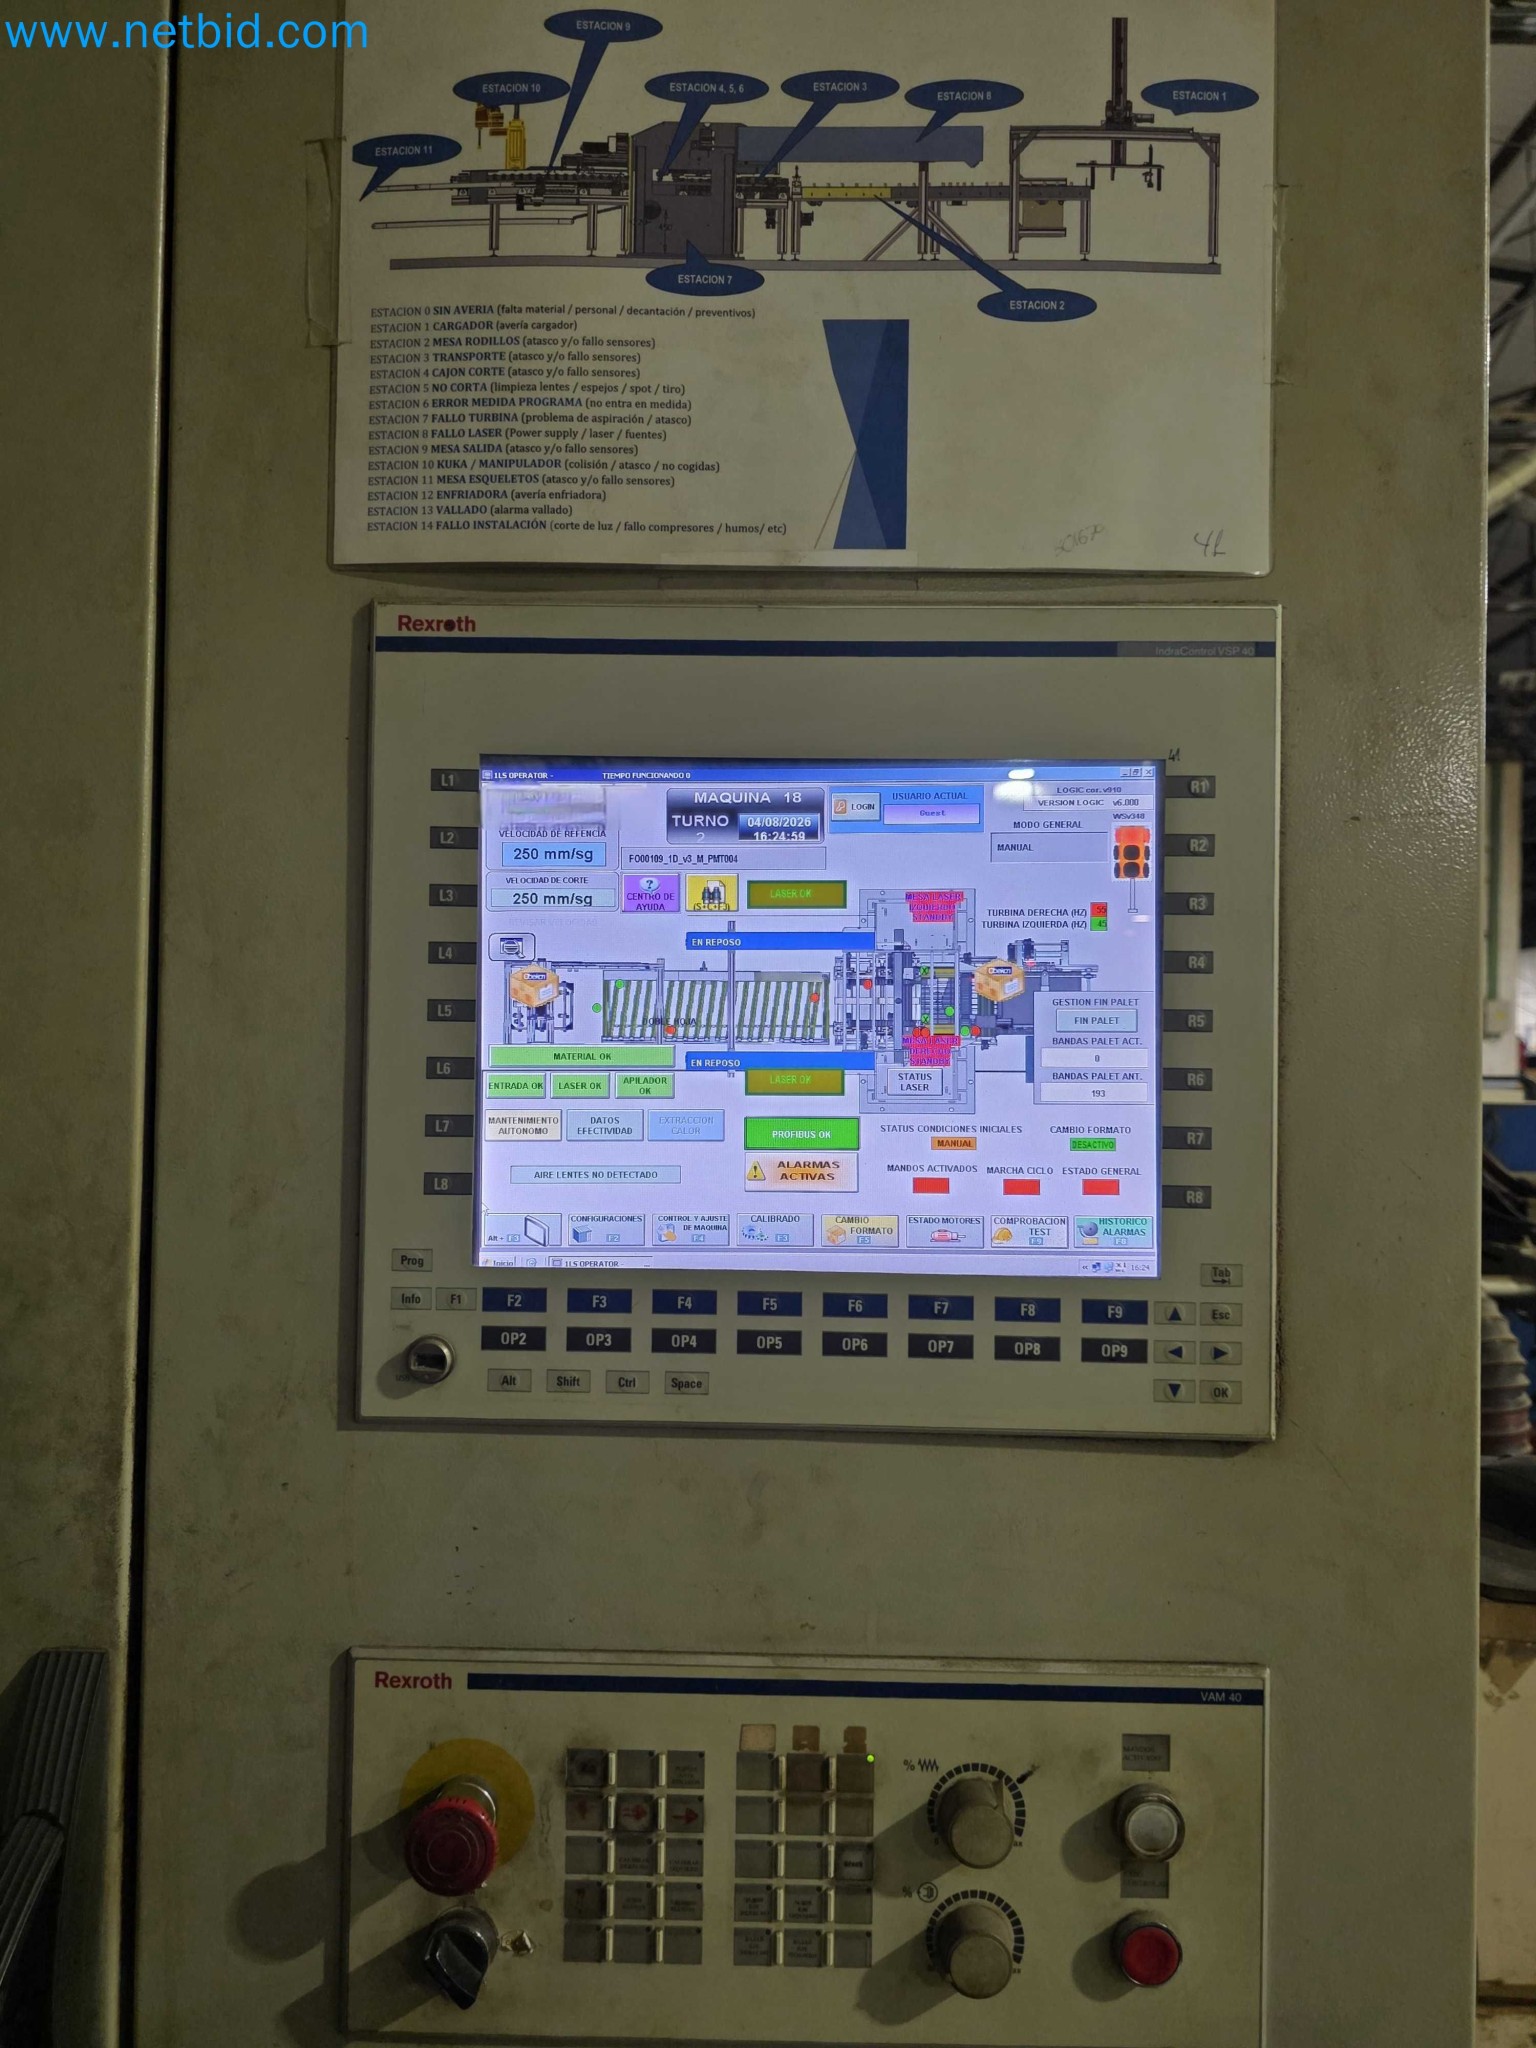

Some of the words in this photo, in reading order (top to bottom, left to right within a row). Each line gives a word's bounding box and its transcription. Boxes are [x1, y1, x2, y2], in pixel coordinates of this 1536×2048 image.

[576, 21, 622, 32] ESTACION
[623, 21, 631, 31] 9
[482, 83, 528, 93] ESTACION
[529, 83, 541, 93] 10
[669, 82, 716, 93] ESTACION
[728, 83, 736, 95] 5,
[738, 83, 745, 93] 6
[812, 81, 859, 92] ESTACION
[860, 81, 868, 92] 3
[937, 90, 984, 102] ESTACION
[984, 90, 992, 101] 8
[1172, 90, 1220, 101] ESTACION
[1220, 91, 1227, 102] 1
[375, 145, 422, 157] ESTACION
[422, 145, 433, 155] 11
[677, 274, 725, 285] ESTACION
[725, 274, 733, 285] 7
[1009, 300, 1057, 312] ESTACION
[1057, 301, 1065, 311] 2
[370, 322, 422, 332] ESTACION
[424, 322, 430, 332] 1
[432, 321, 494, 331] CARGADOR
[496, 319, 528, 332] (avería
[530, 320, 578, 332] cargador)
[368, 400, 420, 410] ESTACION
[422, 399, 430, 409] 6
[432, 399, 468, 409] ERROR
[472, 398, 516, 408] MEDIDA
[518, 398, 582, 408] PROGRAMA
[586, 398, 602, 410] (no
[604, 399, 632, 409] entra
[634, 402, 648, 410] en
[650, 399, 692, 412] medida)
[368, 445, 420, 455] ESTACION
[420, 445, 428, 455] 9
[430, 444, 460, 454] MESA
[462, 444, 502, 454] SALIDA
[506, 443, 542, 455] (atasco
[544, 443, 562, 455] y/o
[564, 444, 586, 454] fallo
[590, 444, 638, 457] sensores)
[368, 506, 418, 516] ESTACION
[422, 506, 434, 516] 13
[436, 505, 488, 515] VALLADO
[490, 504, 530, 516] (alarma
[532, 504, 572, 516] vallado)
[398, 615, 476, 632] Rexroth
[1156, 646, 1216, 656] IndraControl
[1218, 646, 1239, 656] VSP
[1242, 647, 1255, 656] 40
[694, 792, 771, 804] MAQUINA
[783, 792, 802, 803] 18
[892, 792, 929, 800] USUARIO
[932, 792, 968, 800] ACTUAL
[851, 803, 875, 811] LOGIN
[672, 815, 729, 827] TURNO
[747, 817, 812, 829] 04/08/2026
[1013, 821, 1038, 829] MODO
[1042, 821, 1083, 829] GENERAL
[499, 830, 548, 838] VELOCIDAD
[997, 843, 1034, 851] MANUAL
[513, 848, 539, 860] 250
[544, 848, 594, 863] mm/sg
[506, 877, 549, 885] VELOCIDAD
[562, 876, 589, 884] CORTE
[513, 893, 539, 905] 250
[543, 893, 593, 908] mm/sg
[627, 893, 657, 901] CENTRO
[661, 892, 675, 900] DE
[636, 903, 665, 911] AYUDA
[987, 909, 1024, 917] TURBINA
[1026, 909, 1067, 917] DERECHA
[1071, 909, 1087, 918] (HZ)
[692, 938, 702, 946] EN
[705, 938, 741, 946] REPOSO
[1052, 998, 1091, 1006] GESTION
[1094, 998, 1108, 1006] FIN
[1111, 998, 1139, 1006] PALET
[1092, 1017, 1119, 1025] PALET
[623, 1077, 667, 1085] APILADOR
[898, 1073, 932, 1081] STATUS
[489, 1082, 528, 1090] ENTRADA
[531, 1082, 544, 1090] OK
[558, 1082, 586, 1090] LASER
[590, 1082, 602, 1090] OK
[639, 1087, 651, 1095] OK
[900, 1083, 929, 1091] LASER
[1091, 1089, 1105, 1097] 193
[488, 1117, 559, 1125] MANTENIMIENTO
[498, 1127, 548, 1135] AUTONOMO
[772, 1130, 816, 1139] PROFIBUS
[819, 1130, 831, 1139] OK
[880, 1125, 914, 1133] STATUS
[917, 1125, 976, 1133] CONDICIONES
[979, 1125, 1022, 1133] INICIALES
[937, 1139, 973, 1147] MANUAL
[1072, 1140, 1114, 1149] DESACTIVO
[777, 1160, 840, 1169] ALARMAS
[887, 1164, 925, 1173] MANDOS
[927, 1165, 977, 1173] ACTIVADOS
[534, 1171, 554, 1179] AIRE
[556, 1171, 589, 1179] LENTES
[592, 1171, 604, 1179] NO
[606, 1171, 658, 1179] DETECTADO
[780, 1172, 835, 1181] ACTIVAS
[987, 1167, 1025, 1175] MARCHA
[1027, 1167, 1053, 1175] CICLO
[1062, 1167, 1097, 1175] ESTADO
[1100, 1167, 1141, 1175] GENERAL
[570, 1215, 643, 1223] CONFIGURACIONES
[751, 1214, 800, 1223] CALIBRADO
[909, 1216, 940, 1224] ESTADO
[941, 1217, 981, 1225] MOTORES
[1103, 1228, 1146, 1236] ALARMAS
[400, 1254, 424, 1268] Prog
[401, 1293, 421, 1305] Info
[450, 1293, 462, 1305] F1
[507, 1294, 522, 1307] F2
[592, 1295, 607, 1309] F3
[677, 1297, 692, 1310] F4
[762, 1298, 778, 1311] F5
[848, 1299, 862, 1313] F6
[934, 1301, 949, 1314] F7
[1020, 1303, 1036, 1317] F8
[1107, 1305, 1123, 1319] F9
[500, 1332, 527, 1346] OP2
[585, 1333, 612, 1347] OP3
[671, 1334, 697, 1348] OP4
[756, 1336, 782, 1350] OP5
[842, 1337, 868, 1351] OP6
[928, 1339, 954, 1354] OP7
[1014, 1342, 1041, 1356] OP8
[1101, 1343, 1128, 1358] OP9
[501, 1374, 516, 1387] Alt
[556, 1375, 580, 1387] Shift
[618, 1377, 636, 1388] Ctrl
[670, 1378, 702, 1392] Space
[374, 1671, 453, 1689] Rexroth
[1200, 1691, 1226, 1703] VAM
[1229, 1692, 1242, 1703] 40
